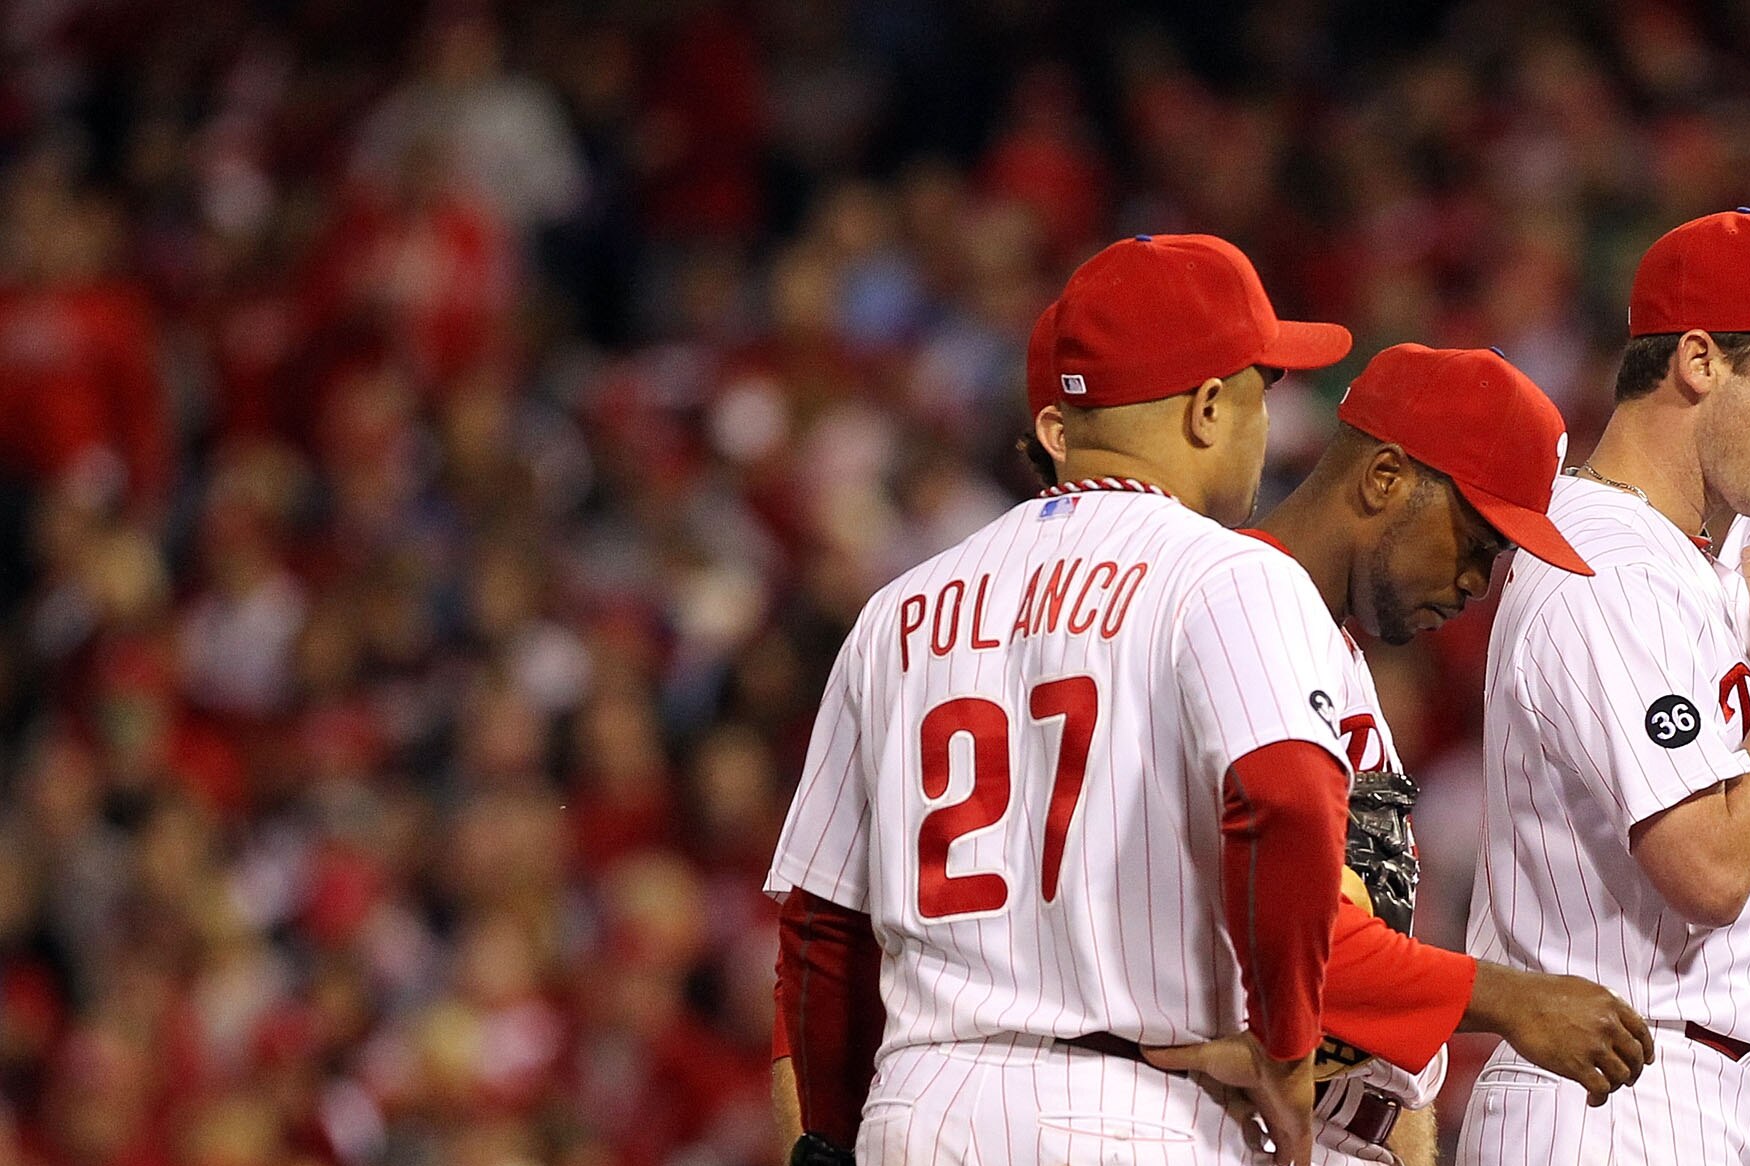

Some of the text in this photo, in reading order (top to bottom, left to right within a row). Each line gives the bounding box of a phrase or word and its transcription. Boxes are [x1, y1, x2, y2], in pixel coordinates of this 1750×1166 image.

[900, 558, 1149, 672] POLANCO
[1651, 703, 1696, 740] 36
[917, 675, 1099, 920] 27
